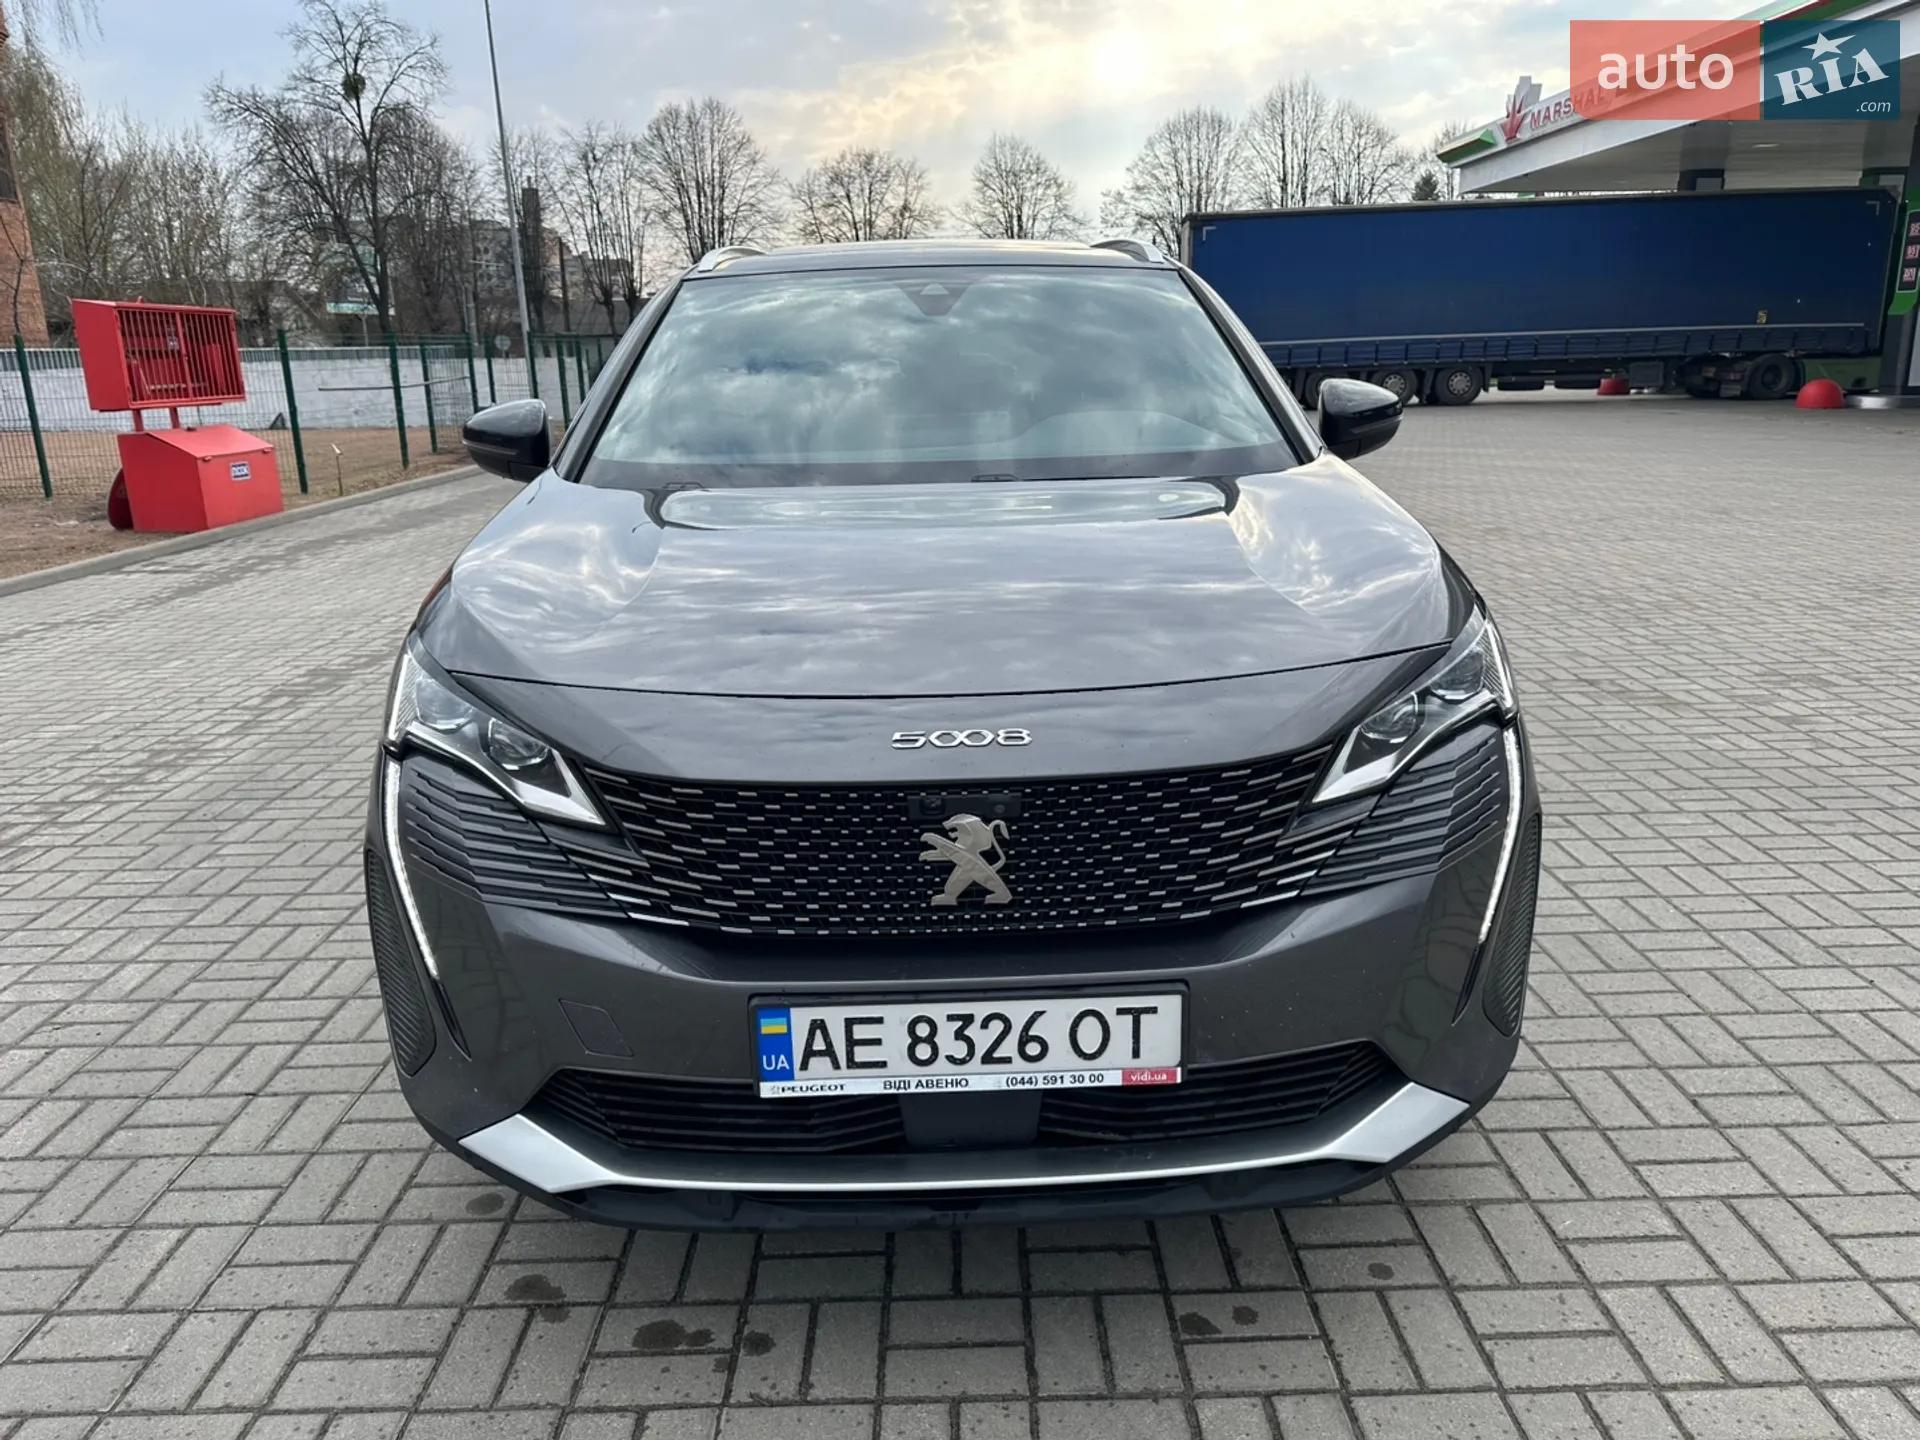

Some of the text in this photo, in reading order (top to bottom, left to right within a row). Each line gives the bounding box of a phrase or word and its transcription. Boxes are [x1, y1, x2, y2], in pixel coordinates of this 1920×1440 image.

[891, 728, 1033, 749] 5008
[799, 1006, 1158, 1071] AE 8326 OT
[763, 1054, 790, 1071] UA
[883, 1077, 969, 1091] ВІДІ АВЕНЮ
[1005, 1073, 1104, 1088] (044) 591 30 00
[1130, 1071, 1167, 1082] vidi.ua
[781, 1083, 846, 1093] PEUGEOT
